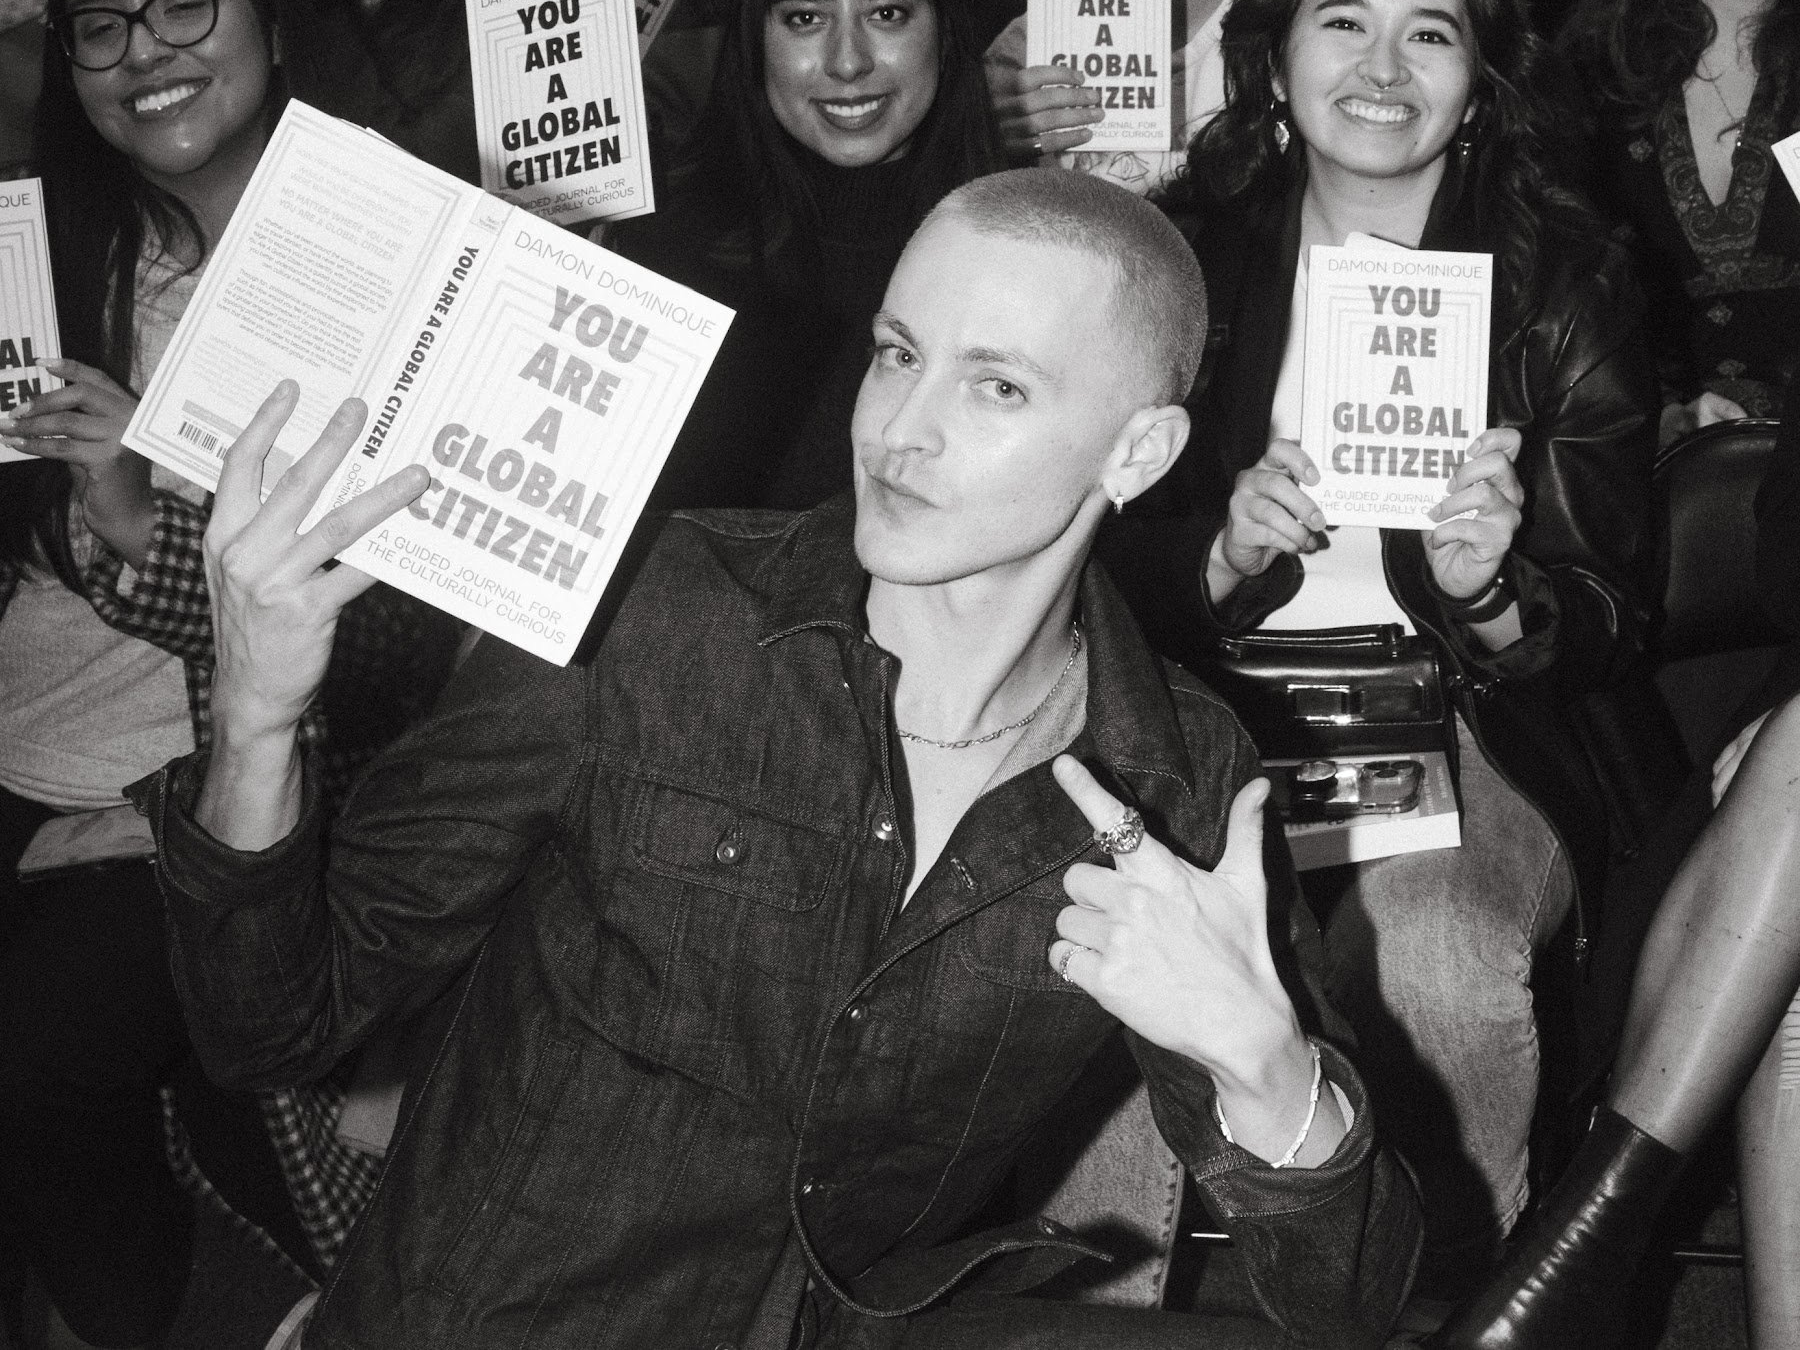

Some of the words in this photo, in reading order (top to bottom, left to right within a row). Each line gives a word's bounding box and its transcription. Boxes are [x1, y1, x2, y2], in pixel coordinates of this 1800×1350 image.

[524, 31, 583, 73] ARE
[1095, 24, 1113, 46] A
[547, 73, 568, 104] A
[502, 97, 620, 152] GLOBAL
[1121, 130, 1164, 138] CURIOUS
[506, 135, 622, 190] CITIZEN
[554, 184, 602, 202] JOURNAL
[604, 178, 626, 190] FOR
[586, 186, 635, 206] CURIOUS
[452, 245, 479, 279] YOU
[1328, 258, 1388, 275] DAMON
[1393, 262, 1482, 280] DOMINIQUE
[434, 281, 461, 314] ARE
[514, 230, 595, 281] DAMON
[598, 270, 717, 340] DOMINIQUE
[1368, 284, 1441, 318] YOU
[427, 315, 442, 330] A
[546, 285, 651, 364] YOU
[1368, 325, 1437, 358] ARE
[394, 330, 436, 395] GLOBAL
[518, 344, 622, 417] ARE
[1389, 365, 1414, 396] A
[361, 394, 404, 460] CITIZEN
[523, 407, 562, 455] A
[1332, 402, 1469, 438] GLOBAL
[432, 422, 612, 538] GLOBAL
[1335, 490, 1379, 500] GUIDED
[1382, 492, 1438, 504] JOURNAL
[1344, 502, 1416, 516] CULTURALLY
[408, 478, 589, 591] CITIZEN
[366, 539, 397, 563] THE
[398, 552, 496, 612] CULTURALLY
[496, 603, 566, 646] CURIOUS
[378, 529, 391, 543] A
[394, 532, 452, 577] GUIDED
[451, 562, 529, 611] JOURNAL
[528, 601, 562, 627] FOR
